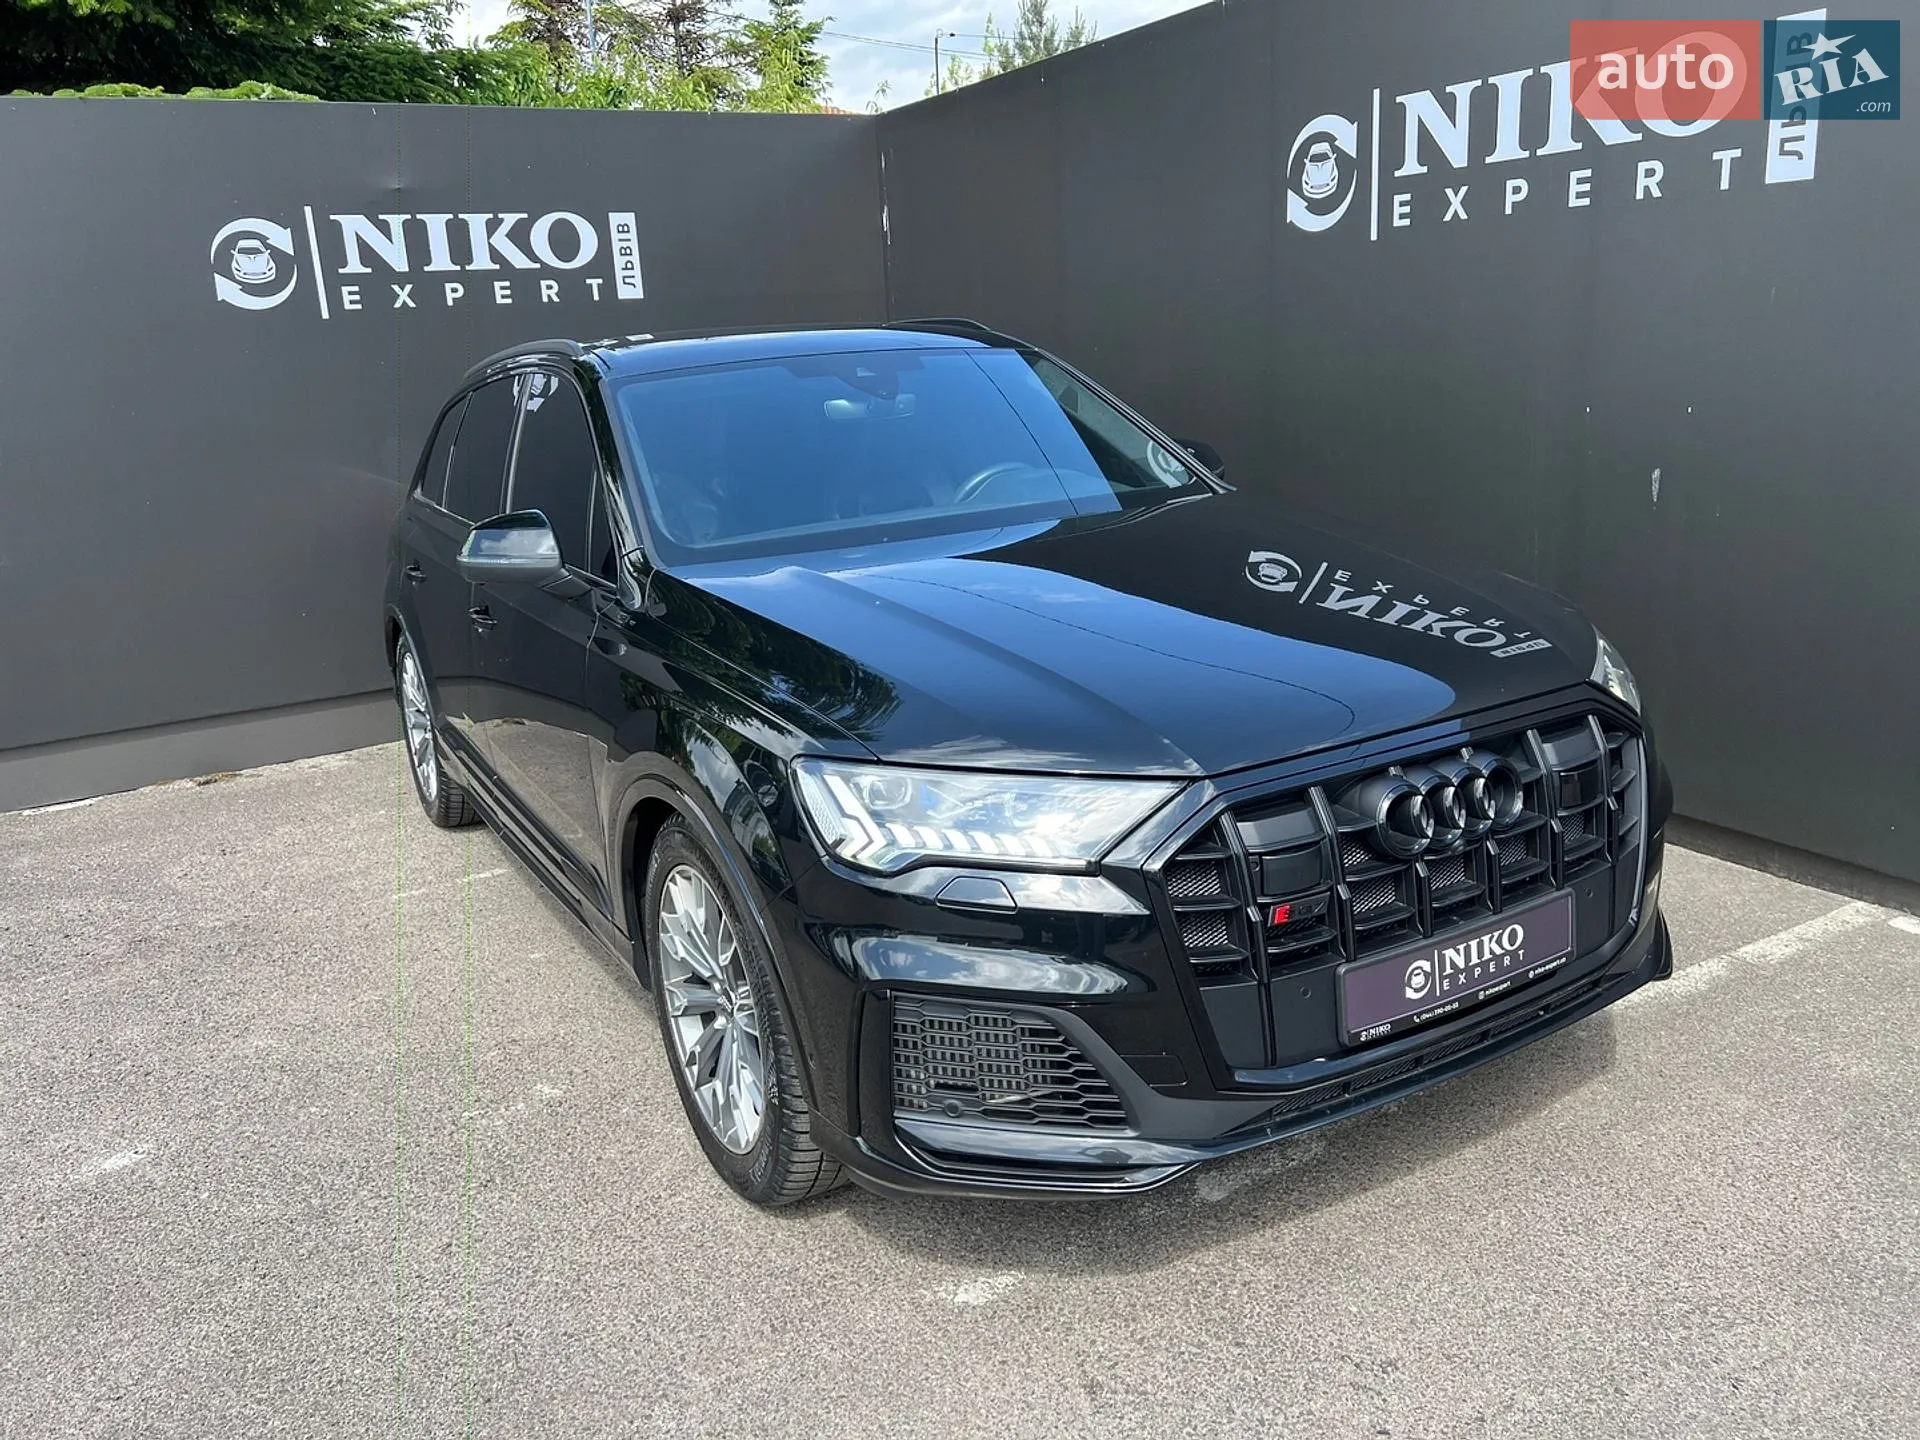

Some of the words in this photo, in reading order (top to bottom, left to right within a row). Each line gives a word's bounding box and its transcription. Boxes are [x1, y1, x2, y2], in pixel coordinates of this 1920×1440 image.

[1394, 31, 1748, 178] NIKO
[1392, 148, 1743, 228] EXPERT
[329, 211, 599, 274] NIKO
[616, 222, 637, 289] ЛЬВІВ
[341, 278, 604, 311] EXPERT
[1442, 924, 1524, 976] NIKO
[1443, 949, 1525, 991] EXPERT
